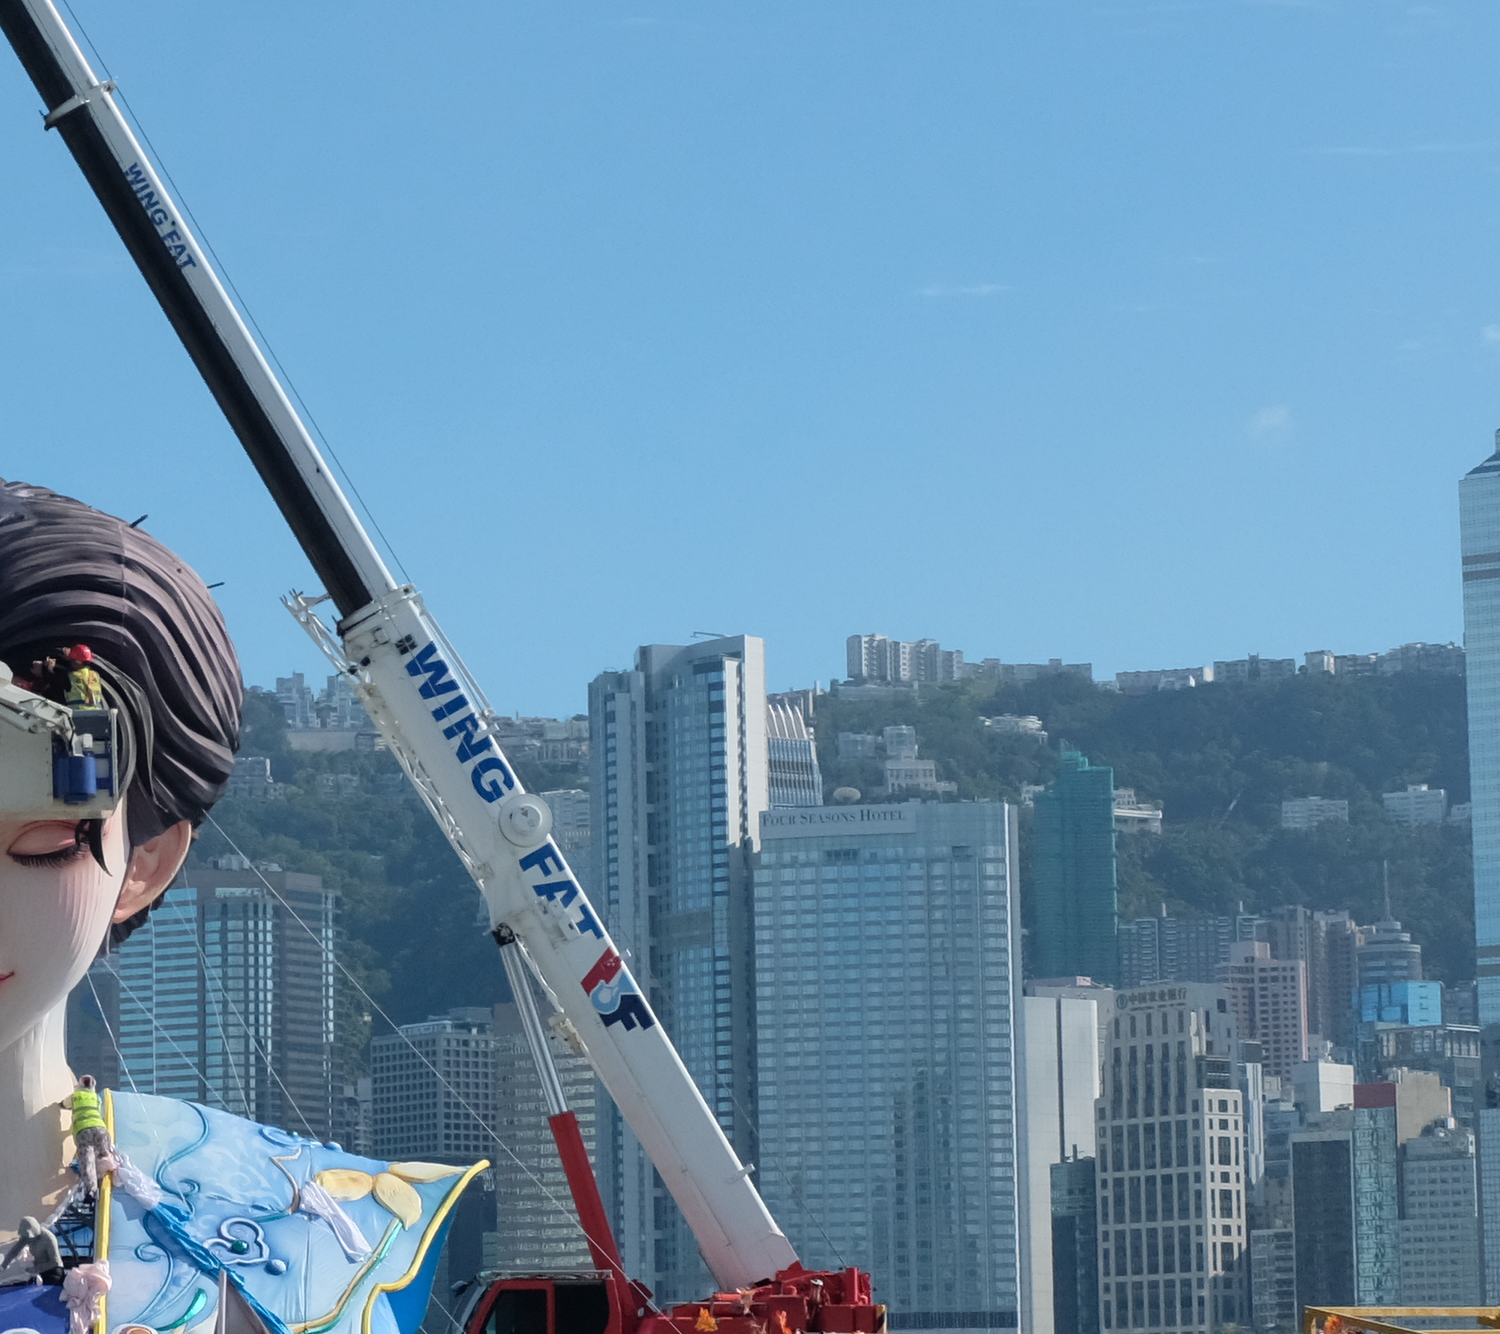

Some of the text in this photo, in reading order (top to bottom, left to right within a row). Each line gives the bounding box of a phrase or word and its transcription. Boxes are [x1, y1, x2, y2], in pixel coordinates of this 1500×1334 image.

[124, 162, 197, 270] WING FAT
[405, 641, 604, 942] WING FAT
[763, 809, 905, 827] FOUR SEASONS HOTEL
